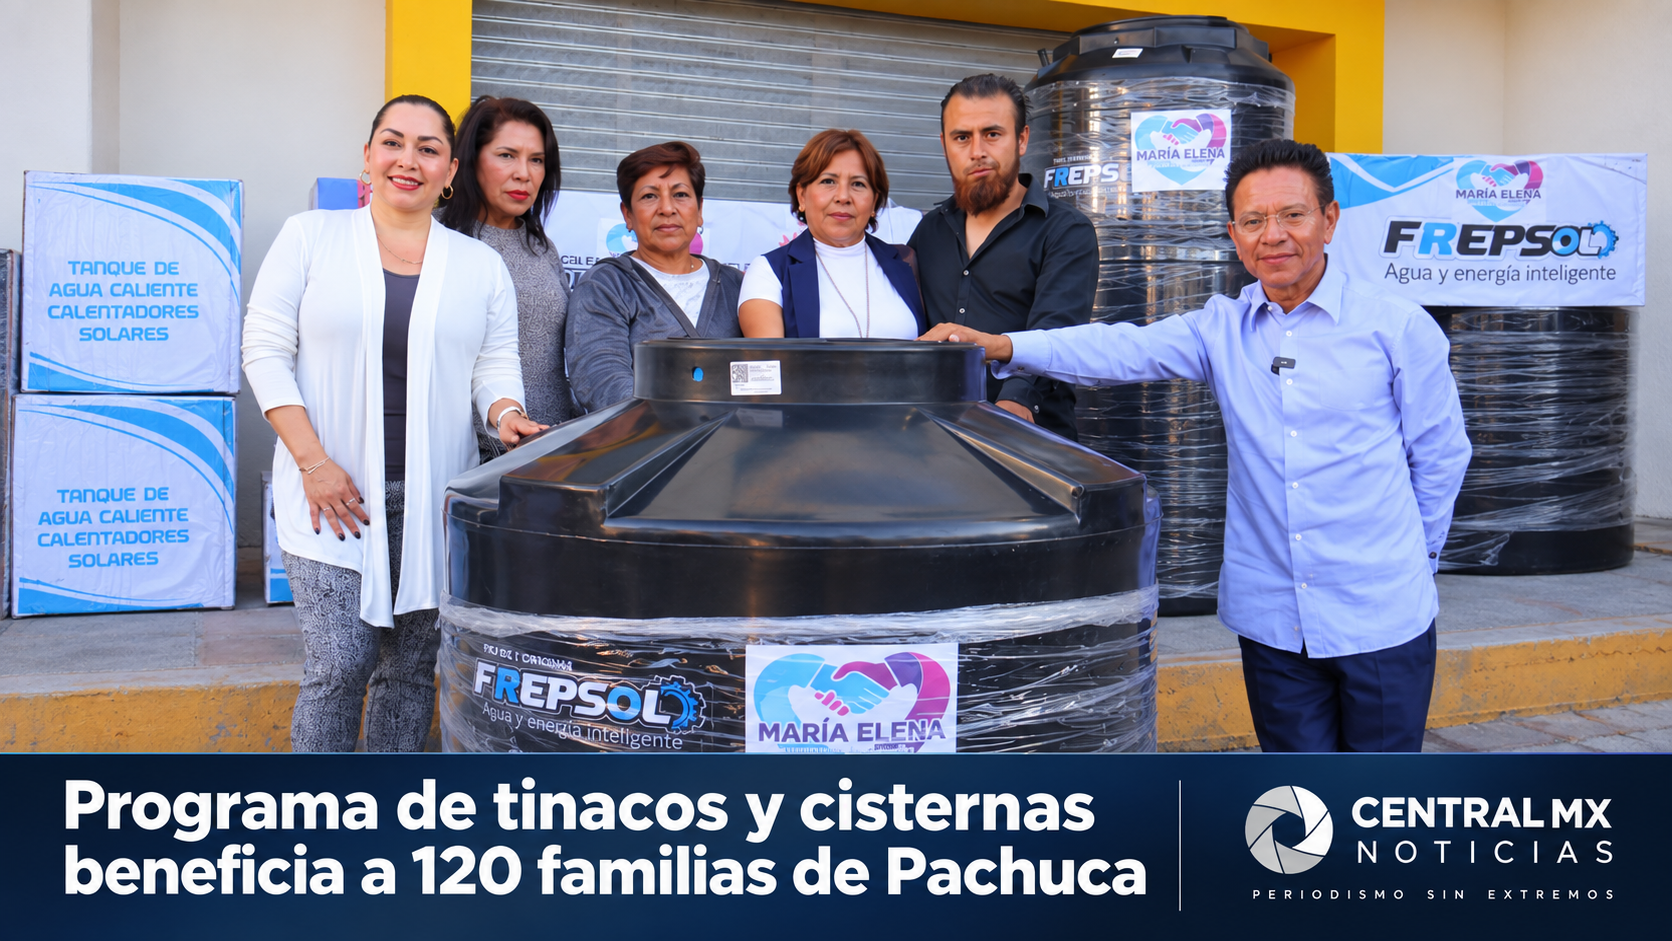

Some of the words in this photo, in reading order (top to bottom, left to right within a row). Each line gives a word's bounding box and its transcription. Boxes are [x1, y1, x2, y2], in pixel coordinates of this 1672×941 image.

[1137, 147, 1180, 161] MARÍA
[1184, 148, 1225, 159] ELENA
[1043, 163, 1120, 190] FREPS
[1456, 188, 1497, 199] MARÍA
[1501, 189, 1541, 199] ELENA
[1384, 219, 1606, 257] FREPSOL
[68, 260, 146, 277] TANQUE
[154, 261, 180, 275] DE
[1384, 262, 1432, 284] Agua
[1438, 269, 1449, 285] y
[1454, 264, 1520, 286] energía
[1526, 263, 1616, 285] inteligente
[49, 283, 103, 297] AGUA
[110, 282, 198, 297] CALIENTE
[47, 304, 199, 320] CALENTADORES
[79, 326, 169, 342] SOLARES
[56, 486, 136, 504] TANQUE
[144, 487, 169, 502] DE
[38, 509, 93, 526] AGUA
[99, 507, 189, 525] CALIENTE
[37, 529, 190, 548] CALENTADORES
[68, 551, 159, 569] SOLARES
[474, 661, 671, 725] FREPSOL
[482, 701, 512, 723] Agua
[515, 713, 524, 728] y
[587, 723, 683, 750] inteligente
[758, 717, 849, 742] MARÍA
[857, 718, 946, 742] ELENA
